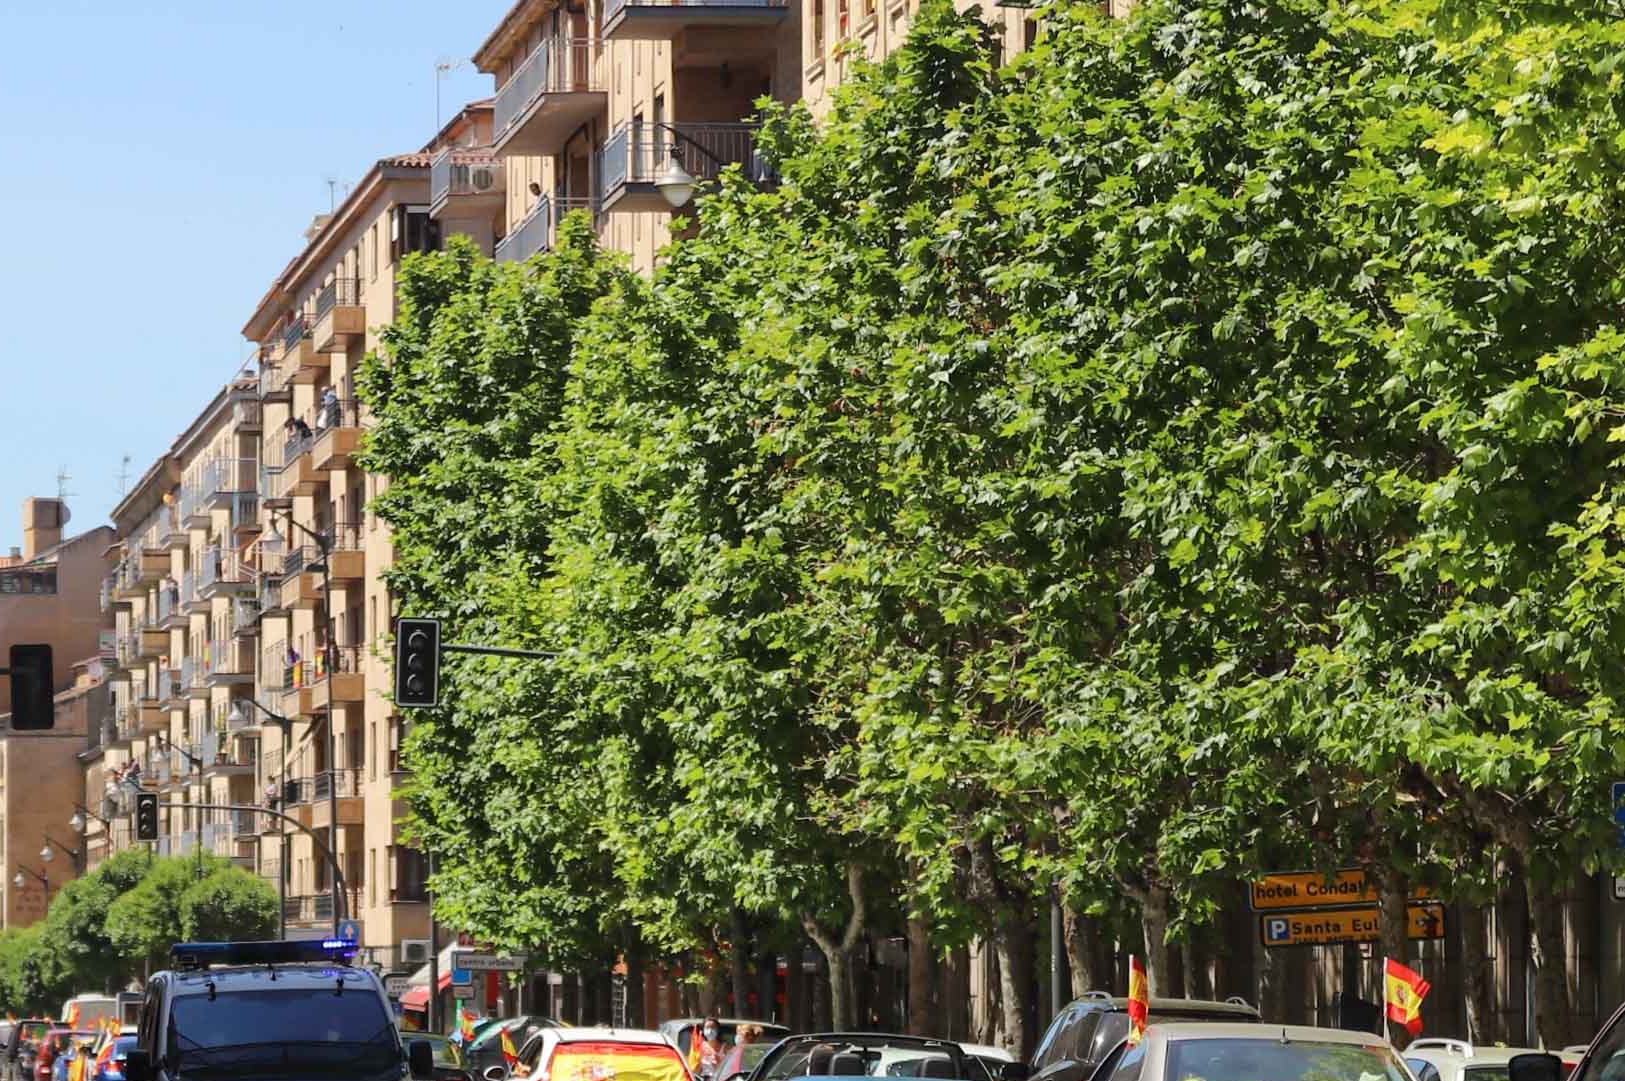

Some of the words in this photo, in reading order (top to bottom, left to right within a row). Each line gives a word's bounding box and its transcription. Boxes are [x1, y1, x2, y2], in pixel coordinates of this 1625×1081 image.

[1255, 883, 1298, 899] hotel
[1271, 920, 1287, 939] P
[1292, 920, 1341, 935] Santa
[1352, 918, 1380, 932] Eul
